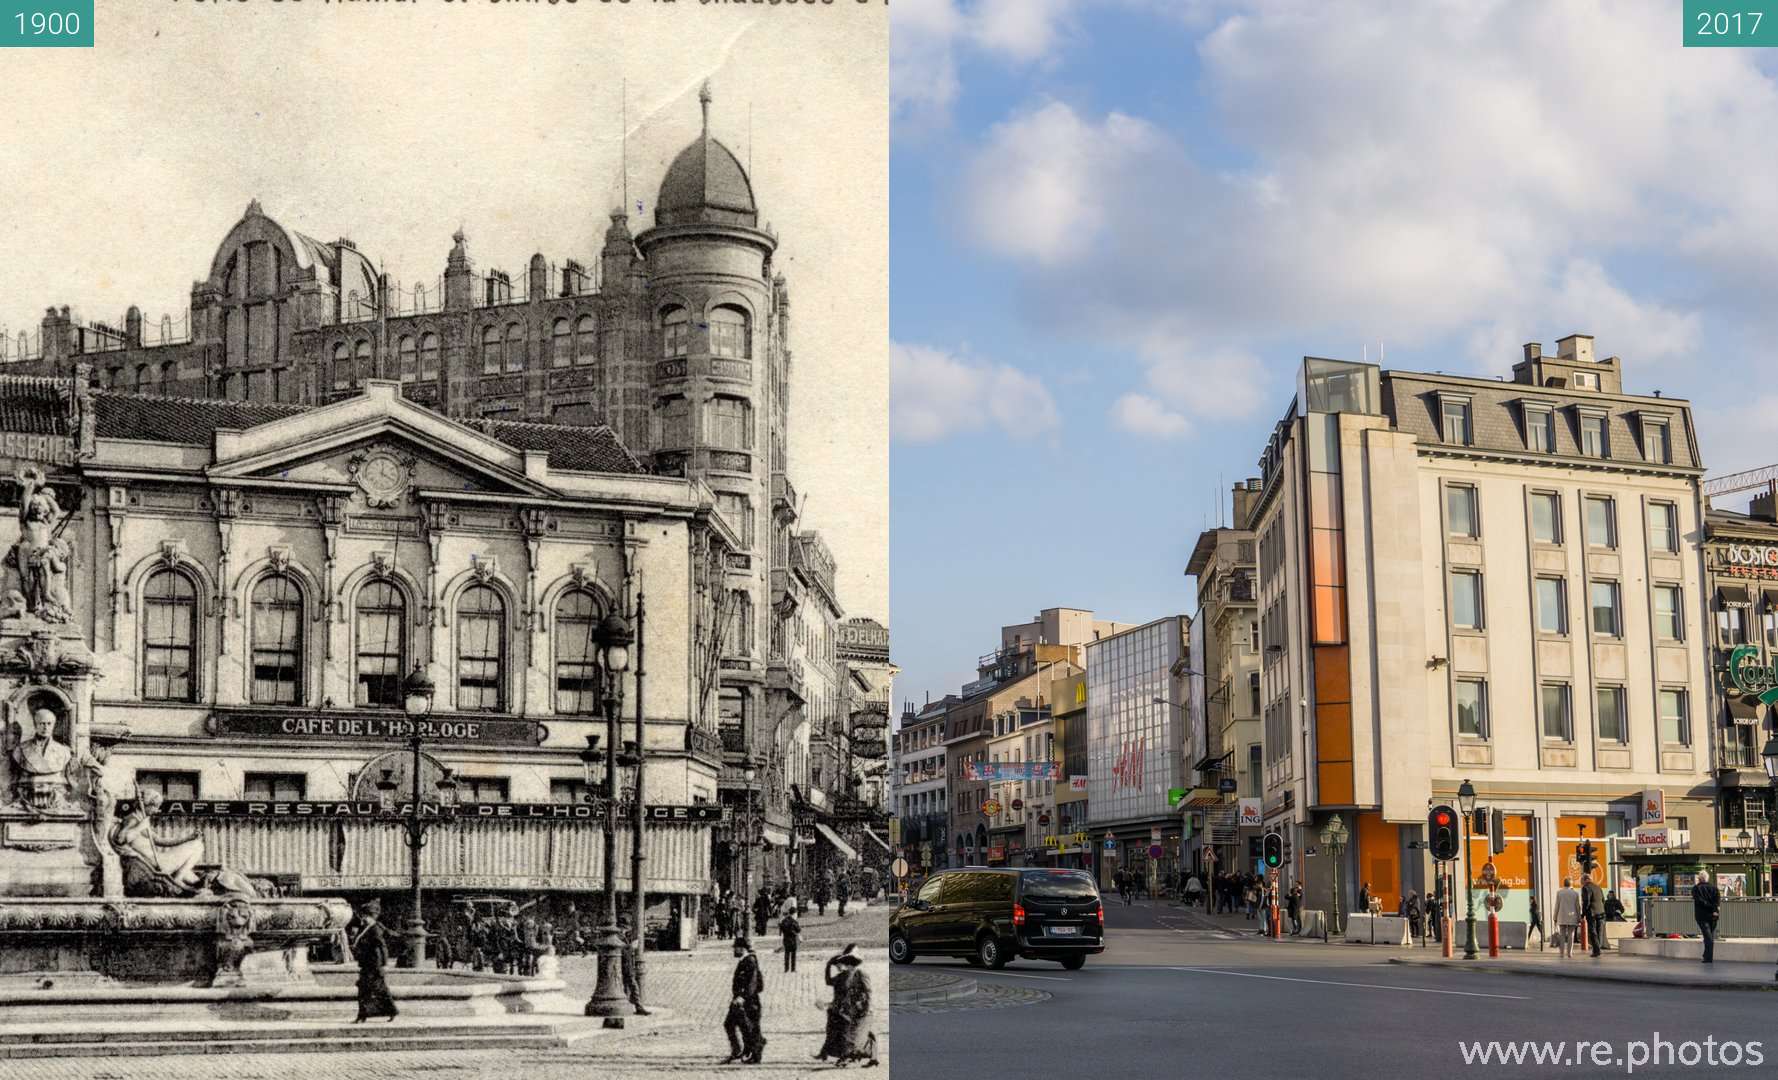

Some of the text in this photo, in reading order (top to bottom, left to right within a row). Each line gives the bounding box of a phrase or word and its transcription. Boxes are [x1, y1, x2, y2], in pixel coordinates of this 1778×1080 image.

[282, 718, 334, 735] CAFE
[338, 719, 363, 736] DE
[157, 802, 230, 814] AFE
[479, 805, 513, 816] DE
[1241, 816, 1260, 824] ING
[1645, 811, 1661, 820] ING
[1638, 833, 1667, 845] Knack
